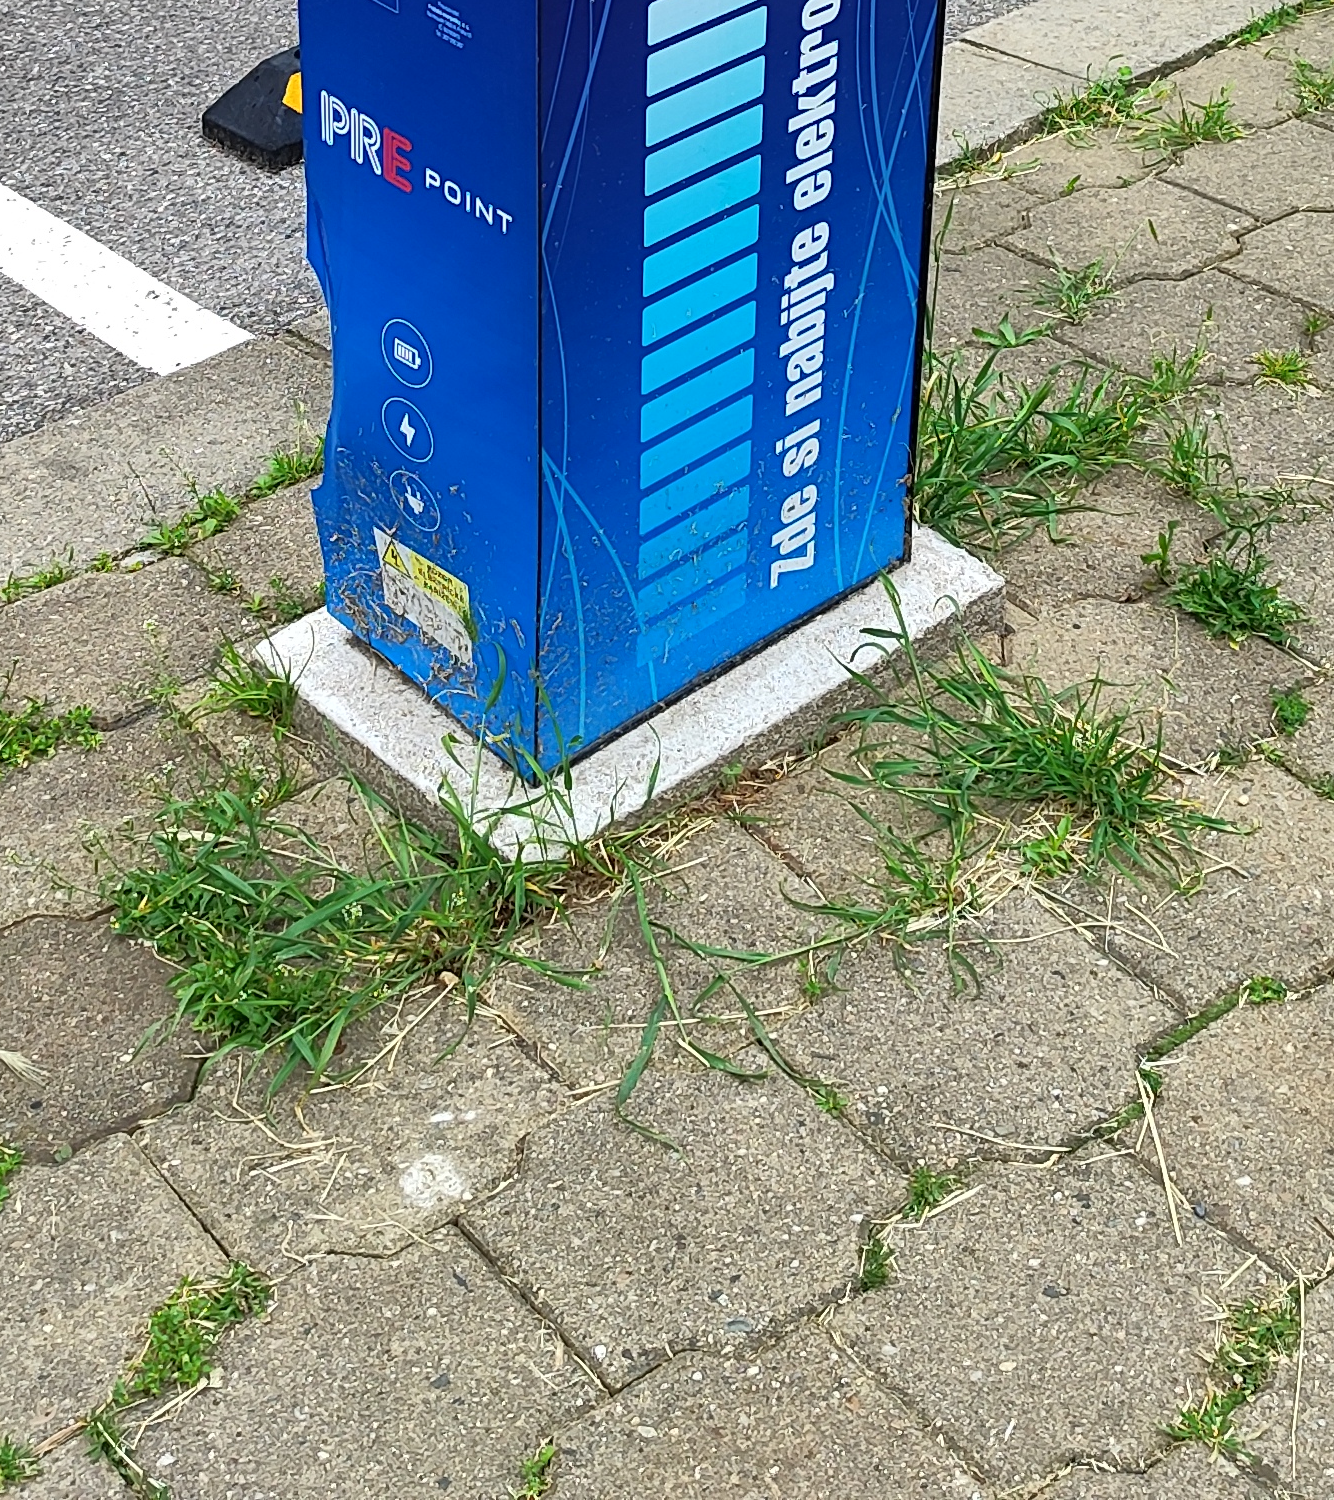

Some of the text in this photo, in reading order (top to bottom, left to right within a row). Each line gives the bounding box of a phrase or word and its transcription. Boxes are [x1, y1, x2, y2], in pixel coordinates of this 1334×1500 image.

[320, 89, 513, 235] PRE POINT
[779, 220, 835, 417] nabijte
[775, 418, 821, 478] si
[769, 483, 818, 590] Zde
